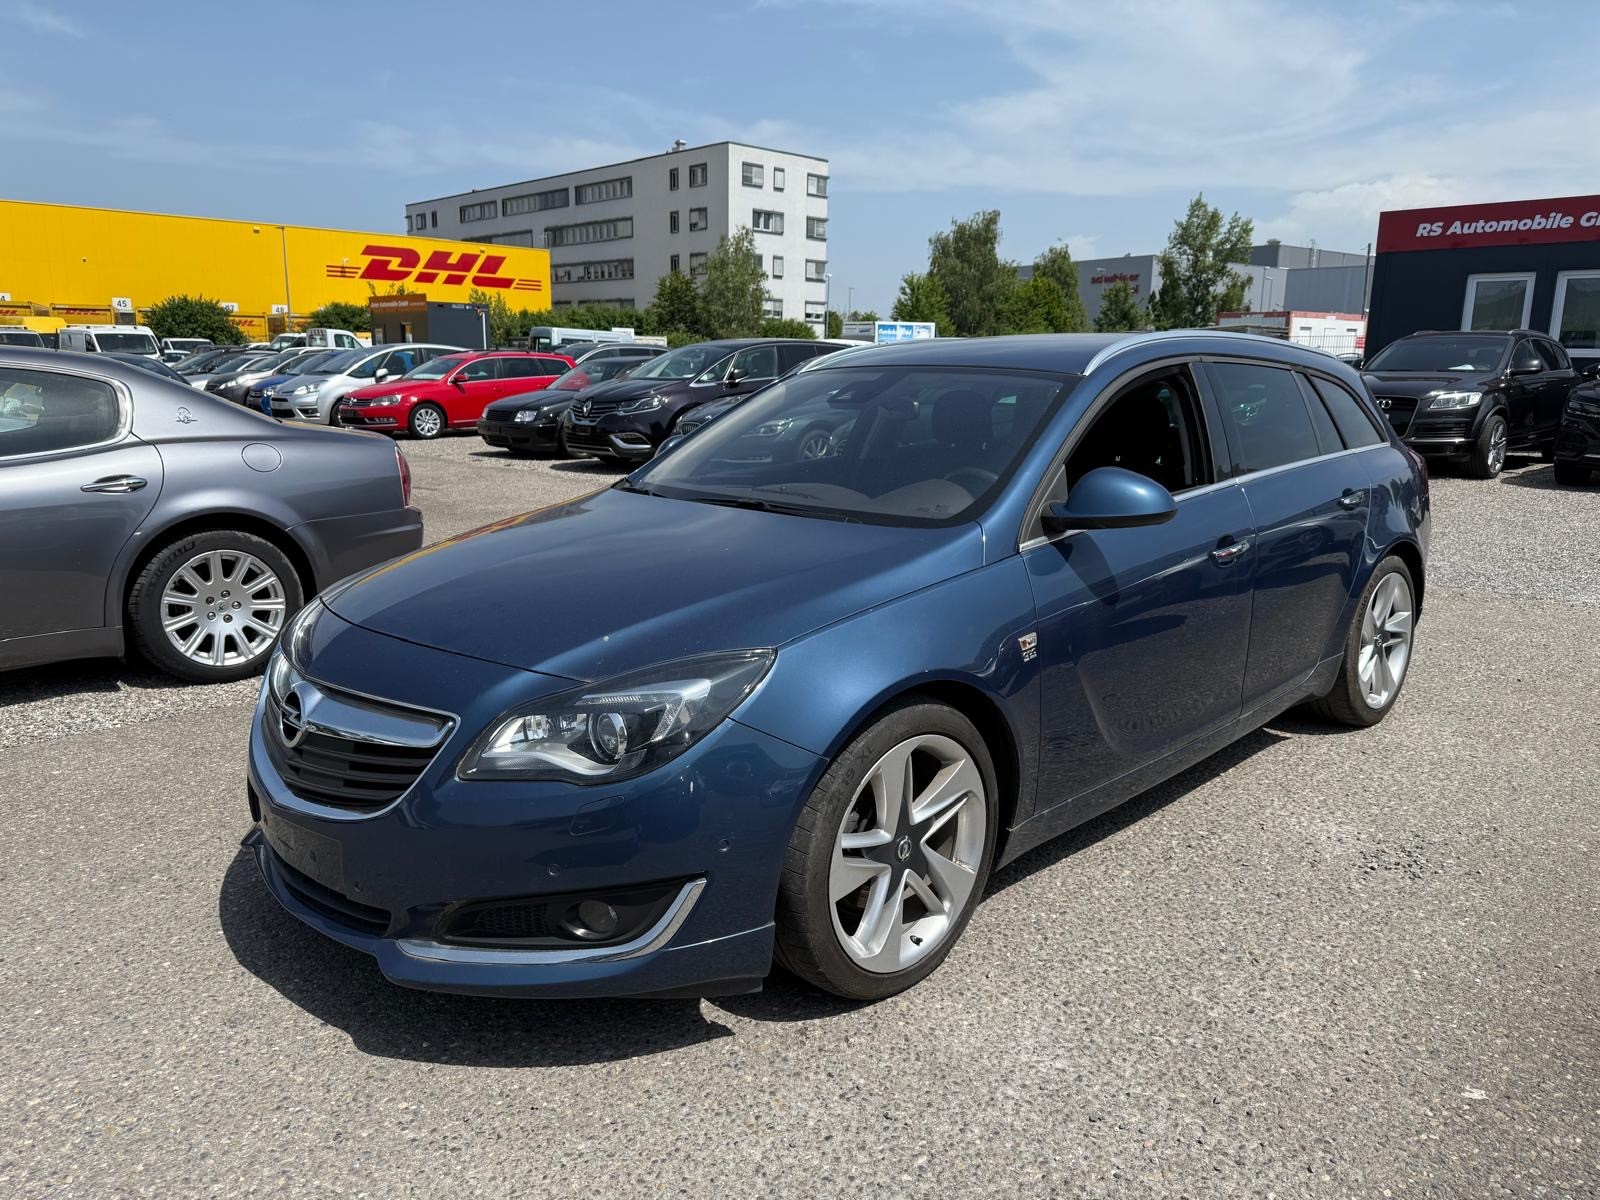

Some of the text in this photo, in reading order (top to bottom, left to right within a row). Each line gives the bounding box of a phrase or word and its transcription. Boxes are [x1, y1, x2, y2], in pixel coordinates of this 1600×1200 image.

[1416, 222, 1444, 237] RS
[1445, 212, 1575, 236] Automobile
[359, 245, 516, 289] DHL
[116, 300, 127, 308] 45
